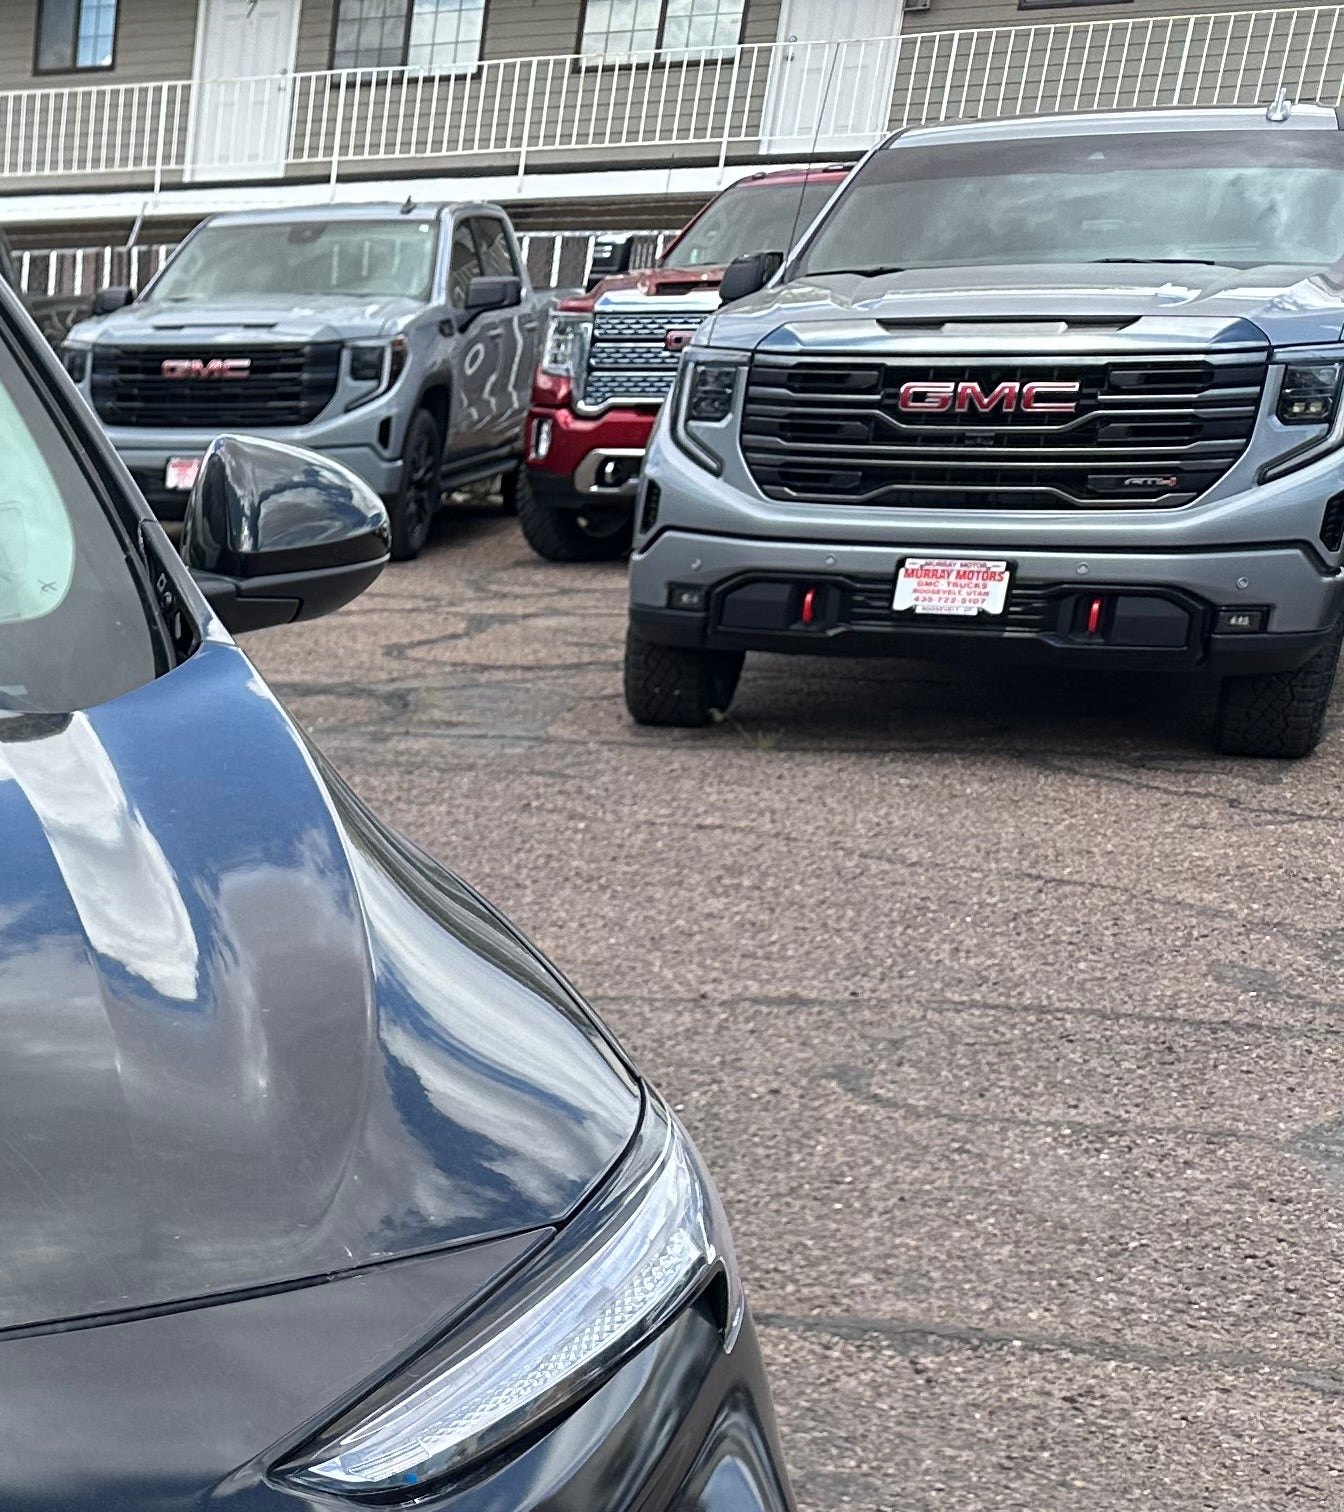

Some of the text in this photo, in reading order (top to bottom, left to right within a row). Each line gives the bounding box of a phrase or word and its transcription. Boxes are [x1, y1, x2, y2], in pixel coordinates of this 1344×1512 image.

[161, 359, 251, 378] GMC
[898, 381, 1080, 412] GMC
[903, 568, 1005, 582] MURRAY MOTORS
